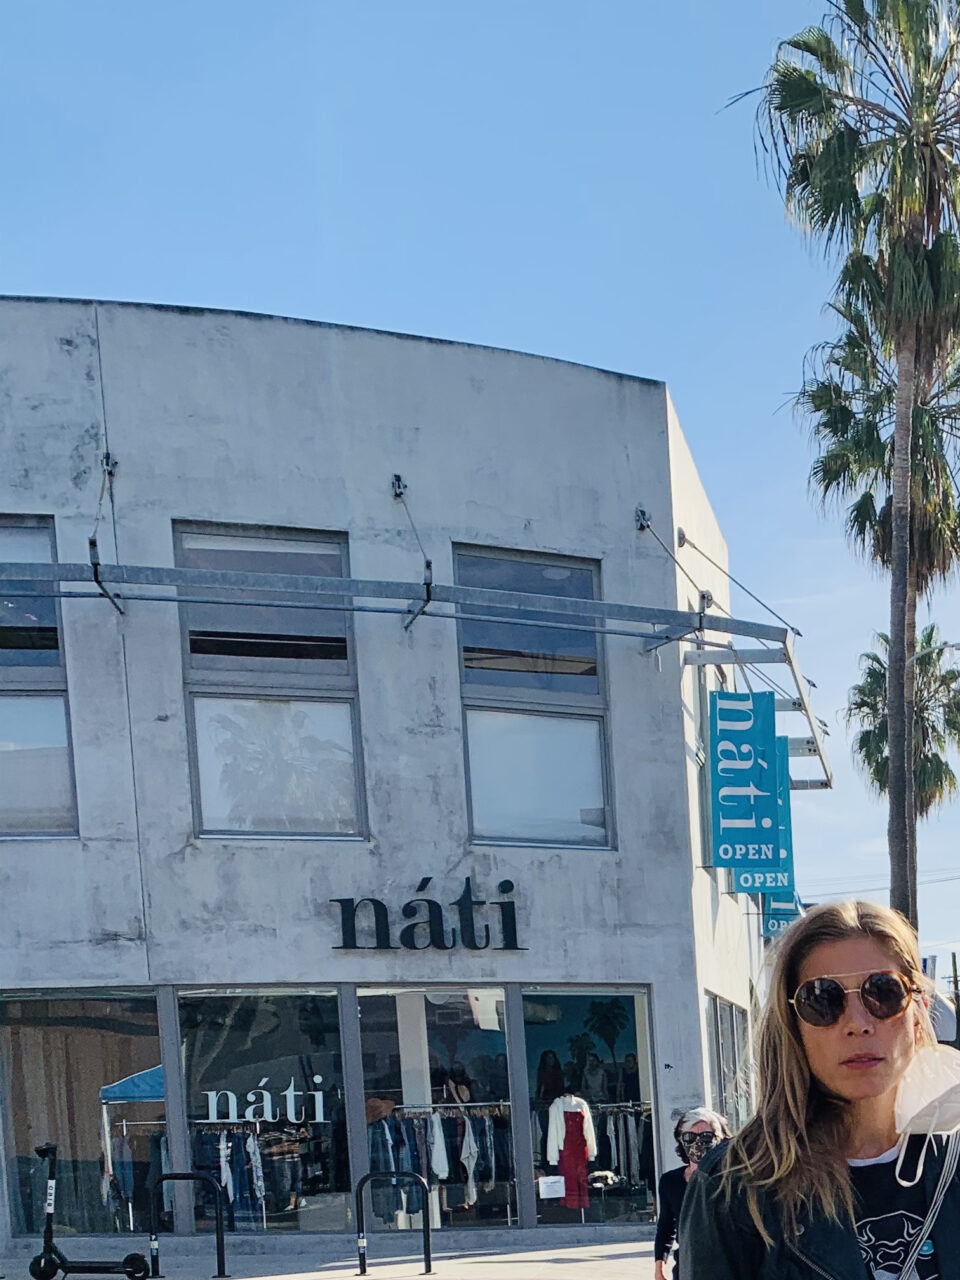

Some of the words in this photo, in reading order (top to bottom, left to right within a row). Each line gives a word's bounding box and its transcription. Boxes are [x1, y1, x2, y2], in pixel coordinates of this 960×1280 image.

[716, 692, 772, 835] náti
[718, 843, 774, 860] OPEN
[739, 872, 789, 888] OPEN
[329, 876, 530, 950] náti
[200, 1074, 331, 1124] náti
